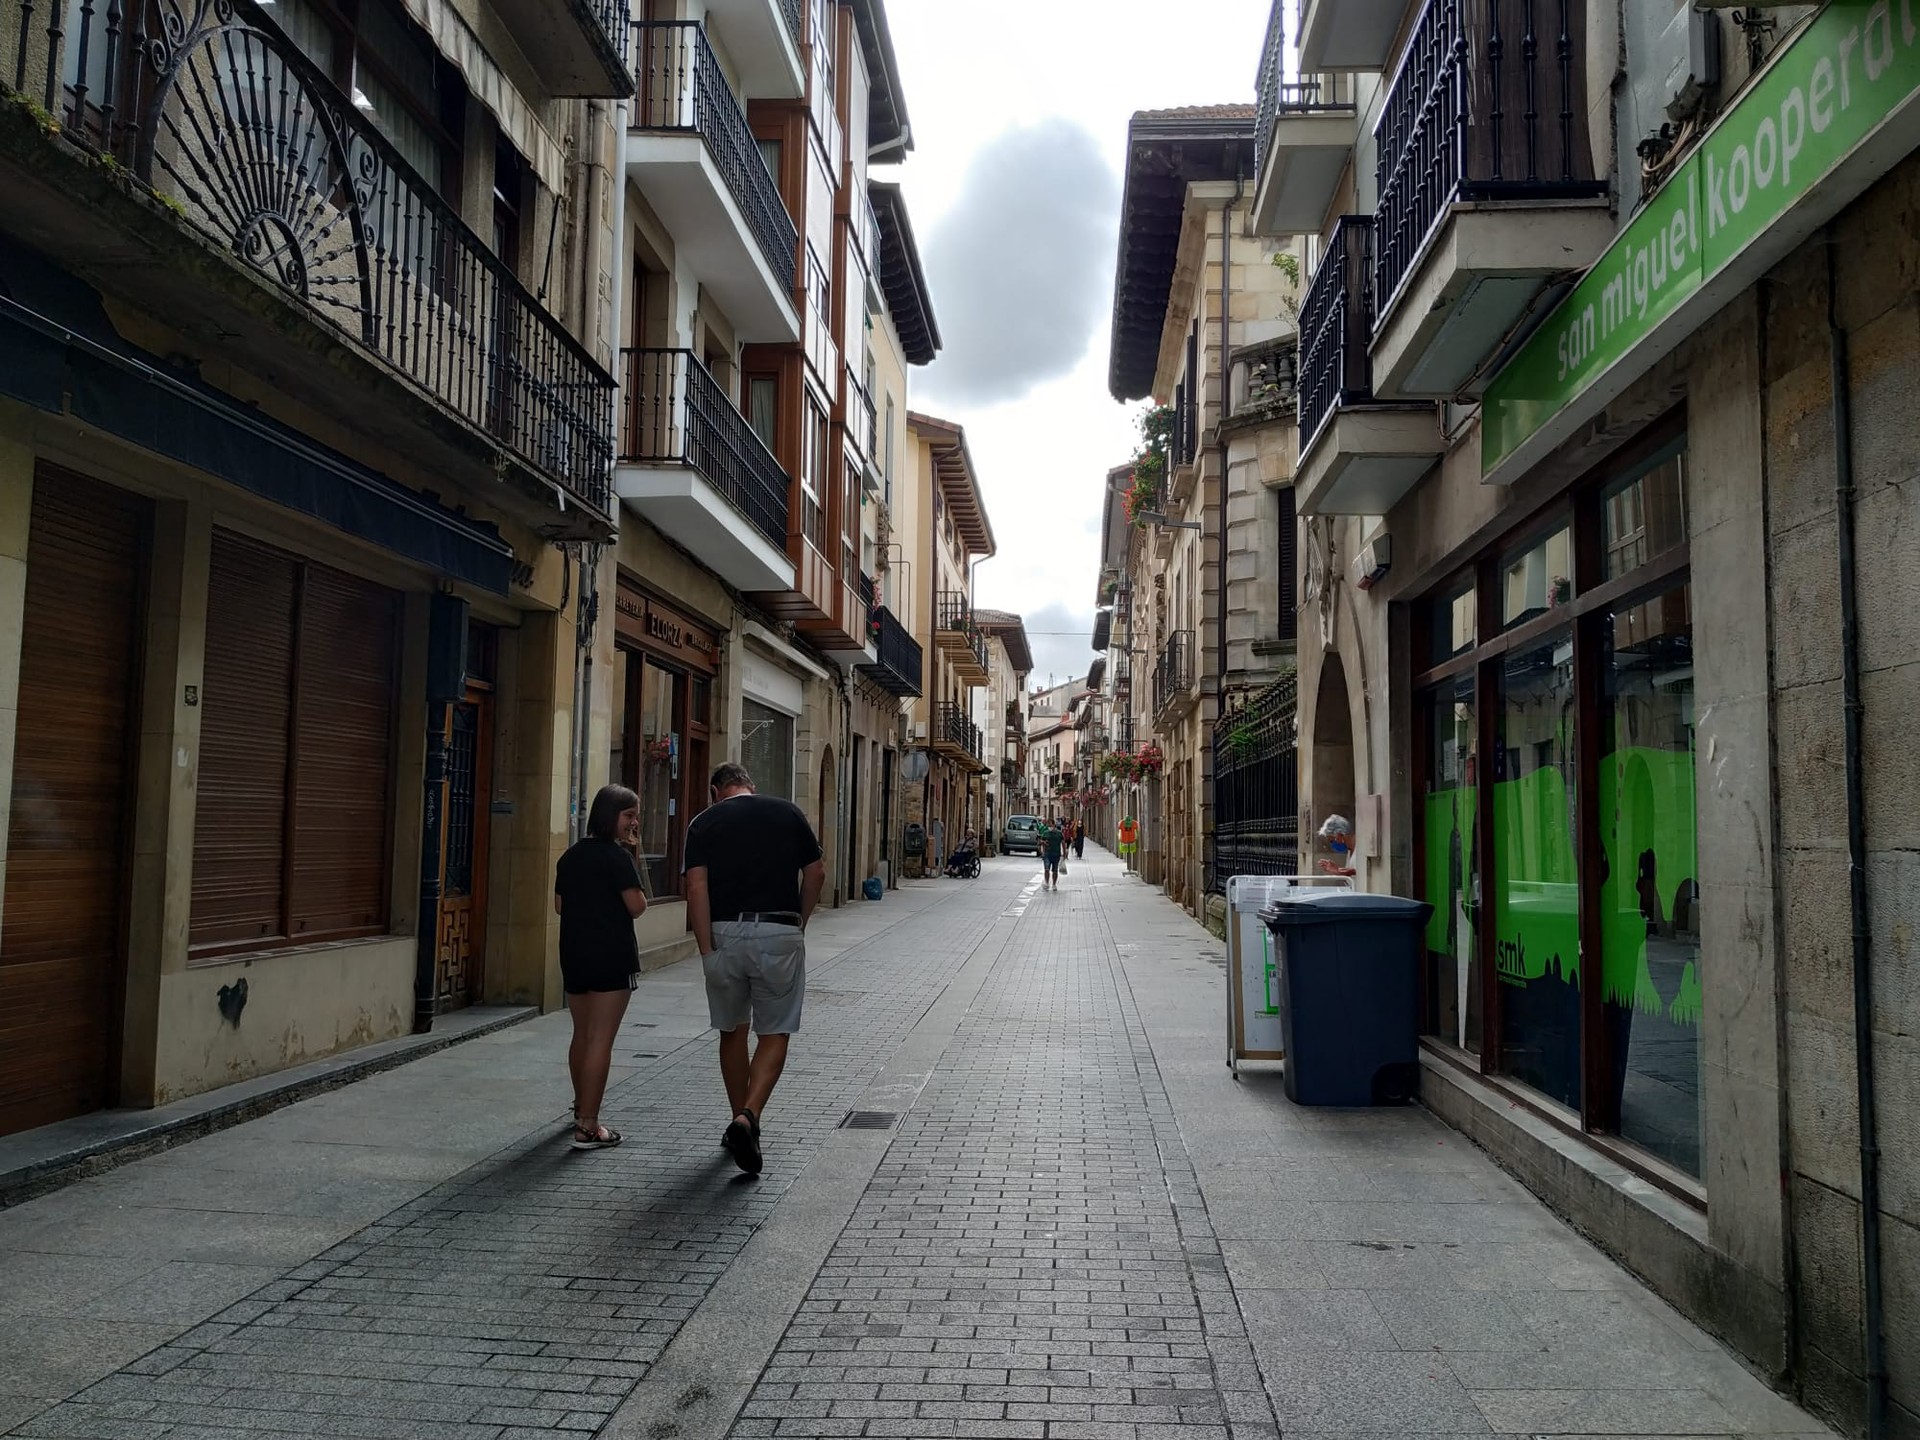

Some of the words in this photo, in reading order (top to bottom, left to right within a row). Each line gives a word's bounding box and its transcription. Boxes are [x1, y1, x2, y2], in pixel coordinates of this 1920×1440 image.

[1558, 304, 1595, 381] san
[1602, 177, 1698, 340] miguel
[651, 613, 683, 647] ELORZA
[1498, 932, 1526, 975] smk
